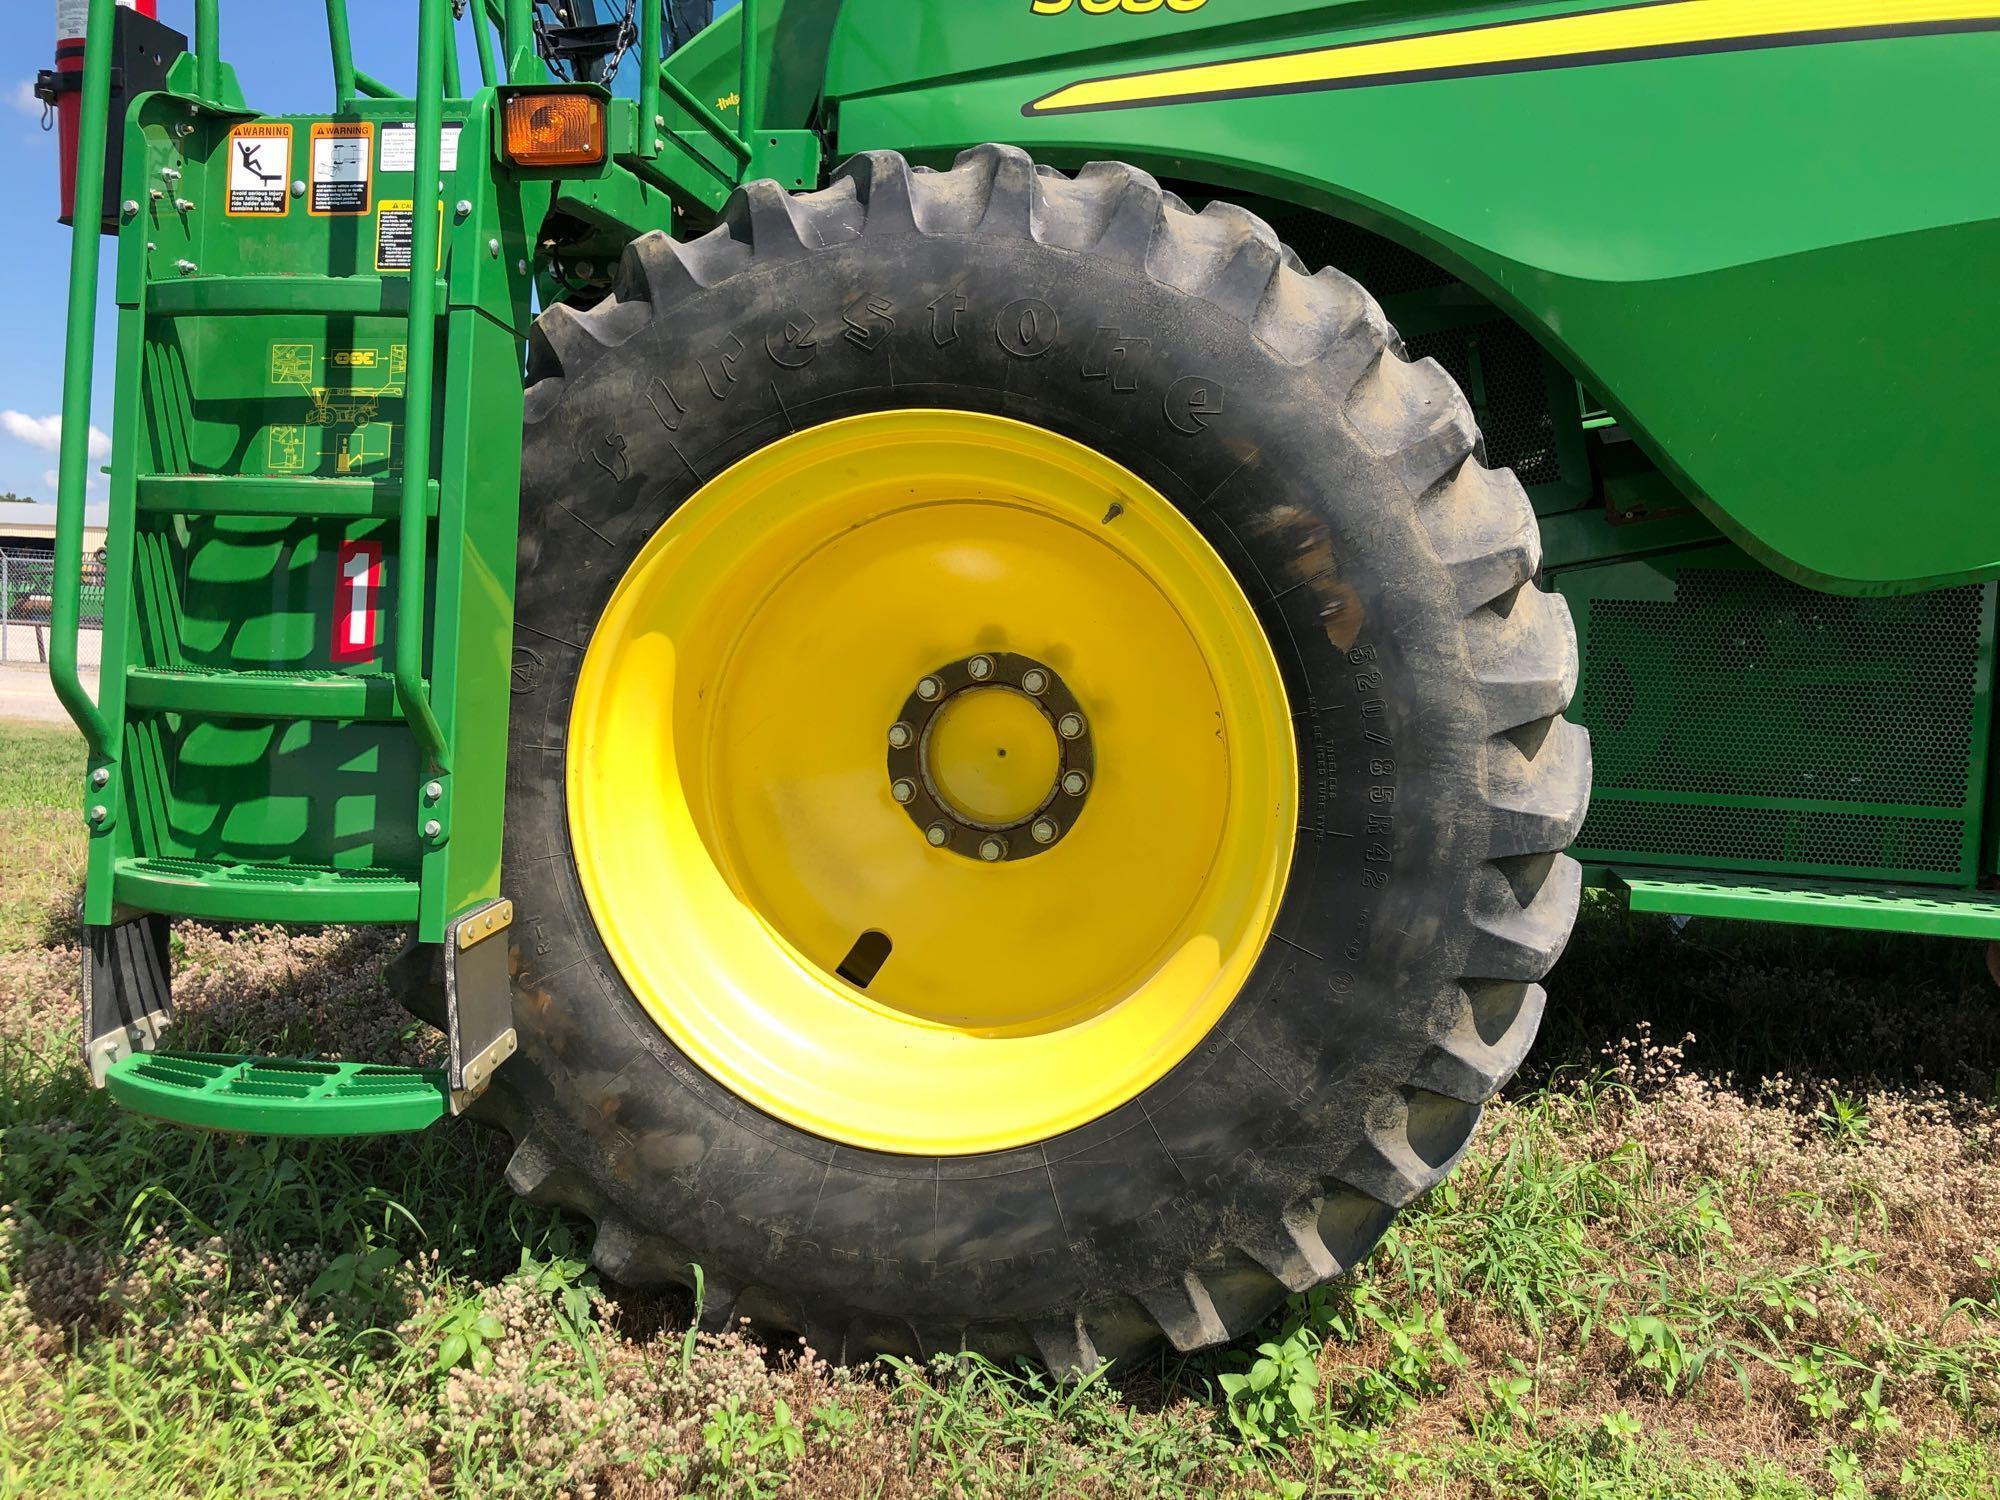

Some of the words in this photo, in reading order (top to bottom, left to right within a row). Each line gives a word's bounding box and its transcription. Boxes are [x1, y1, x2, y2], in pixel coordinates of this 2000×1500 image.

[243, 126, 289, 136] WARNING
[326, 126, 369, 135] WARNING
[578, 289, 1226, 484] Firestone
[343, 552, 370, 645] 1
[1348, 643, 1398, 890] 520/85R42
